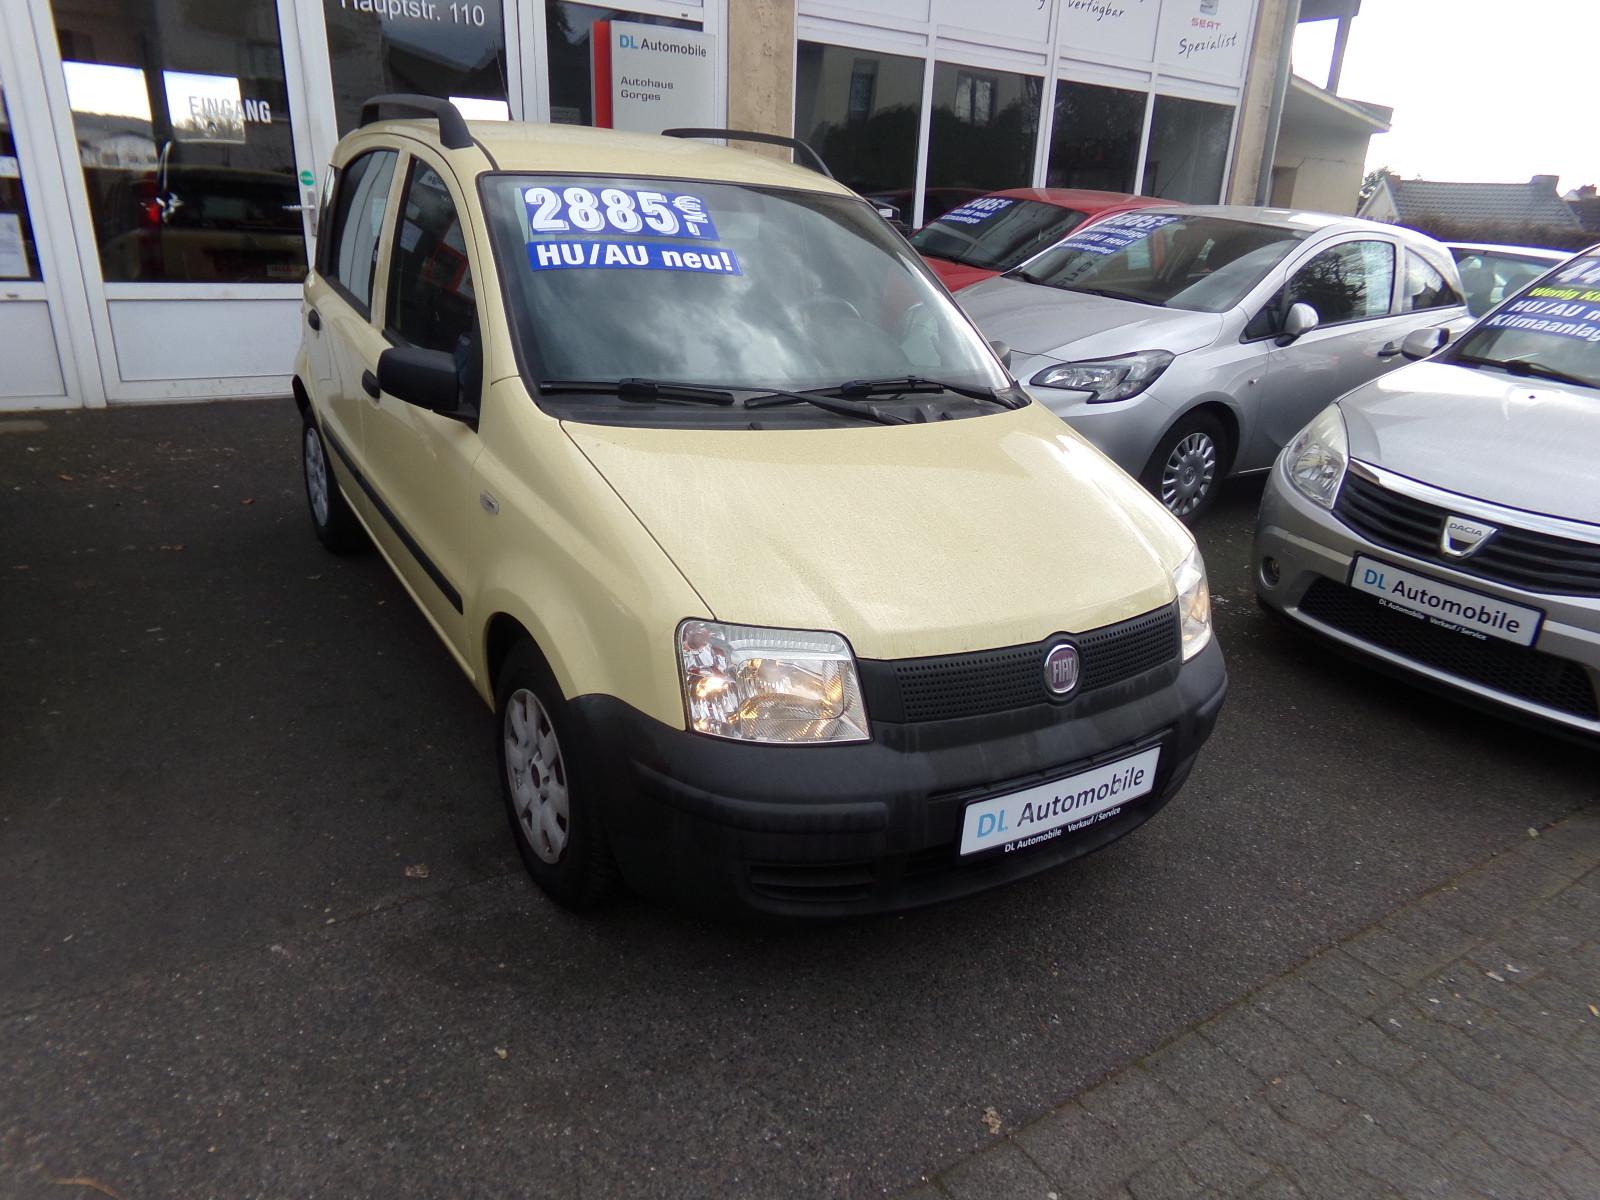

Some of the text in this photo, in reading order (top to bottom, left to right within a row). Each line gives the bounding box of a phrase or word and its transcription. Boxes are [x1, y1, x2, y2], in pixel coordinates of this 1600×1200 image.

[449, 2, 485, 26] 110
[1191, 17, 1221, 30] SEAT
[619, 34, 707, 57] DL Automobile
[1178, 31, 1237, 59] Spezialist
[620, 75, 674, 89] Autohaus
[620, 89, 661, 102] Gorges
[188, 95, 272, 124] EINGANG
[536, 244, 733, 271] HU/AU neu!
[1507, 300, 1587, 317] HU/AU
[1449, 522, 1483, 537] DACIA
[1364, 568, 1521, 634] DL Automobile
[1052, 657, 1073, 684] FIAT
[976, 766, 1145, 838] DL Automobile
[1004, 842, 1016, 853] DL
[1017, 828, 1062, 850] Automobile
